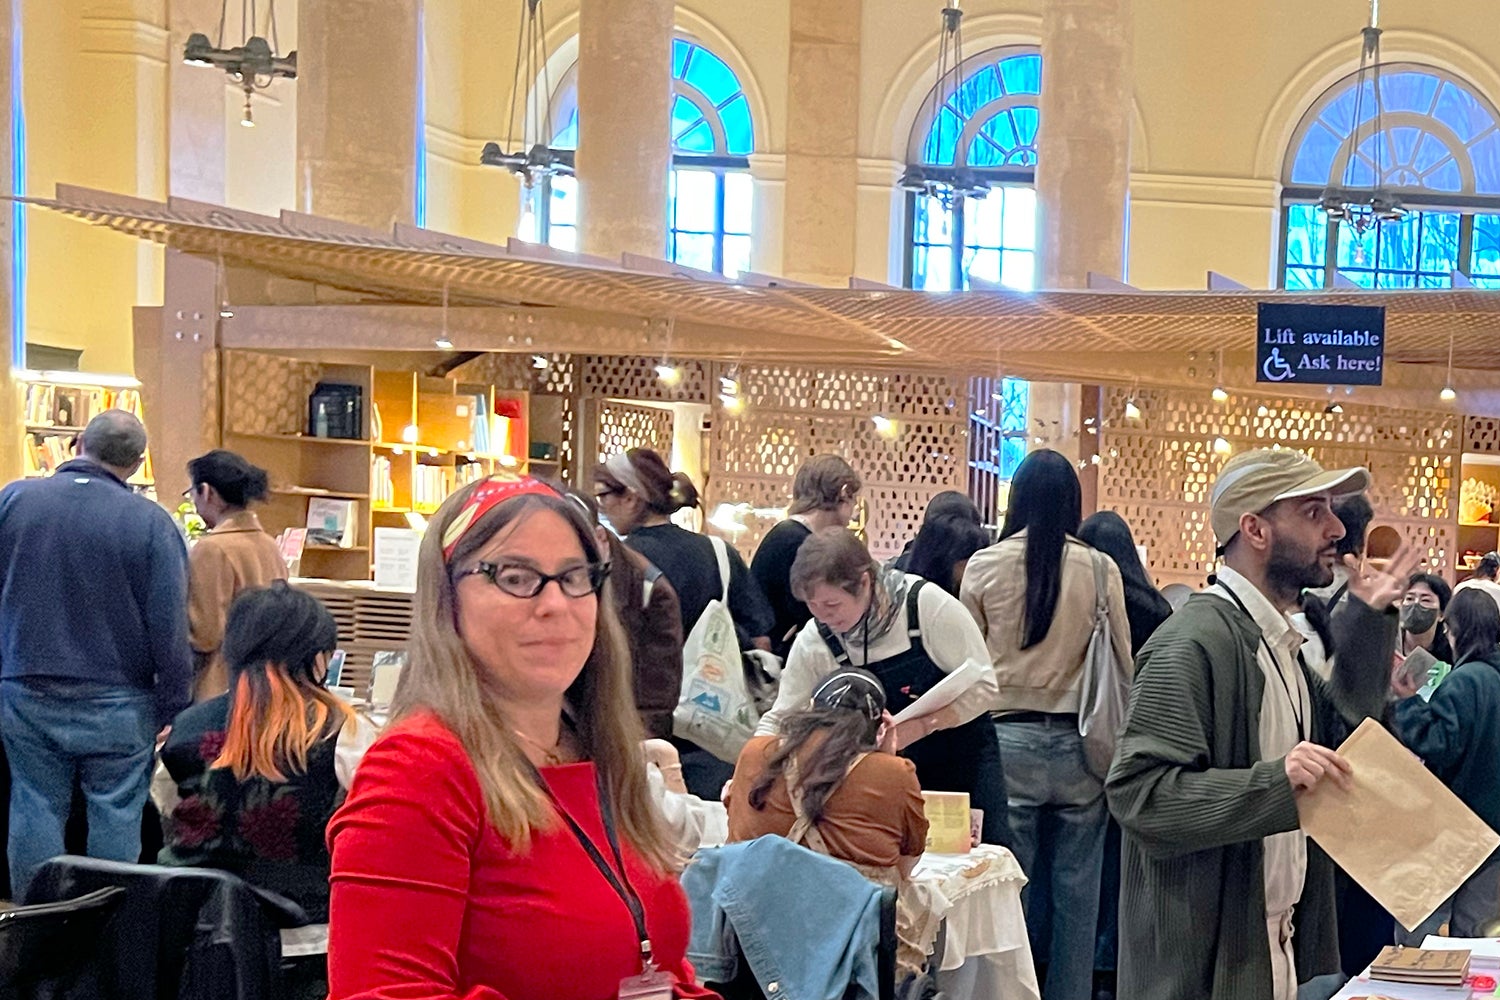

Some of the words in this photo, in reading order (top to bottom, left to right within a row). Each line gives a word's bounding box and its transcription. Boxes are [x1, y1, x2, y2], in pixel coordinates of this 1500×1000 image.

[1264, 328, 1296, 345] Lift
[1302, 329, 1380, 346] available
[1297, 353, 1331, 370] Ask
[1336, 354, 1381, 372] here!
